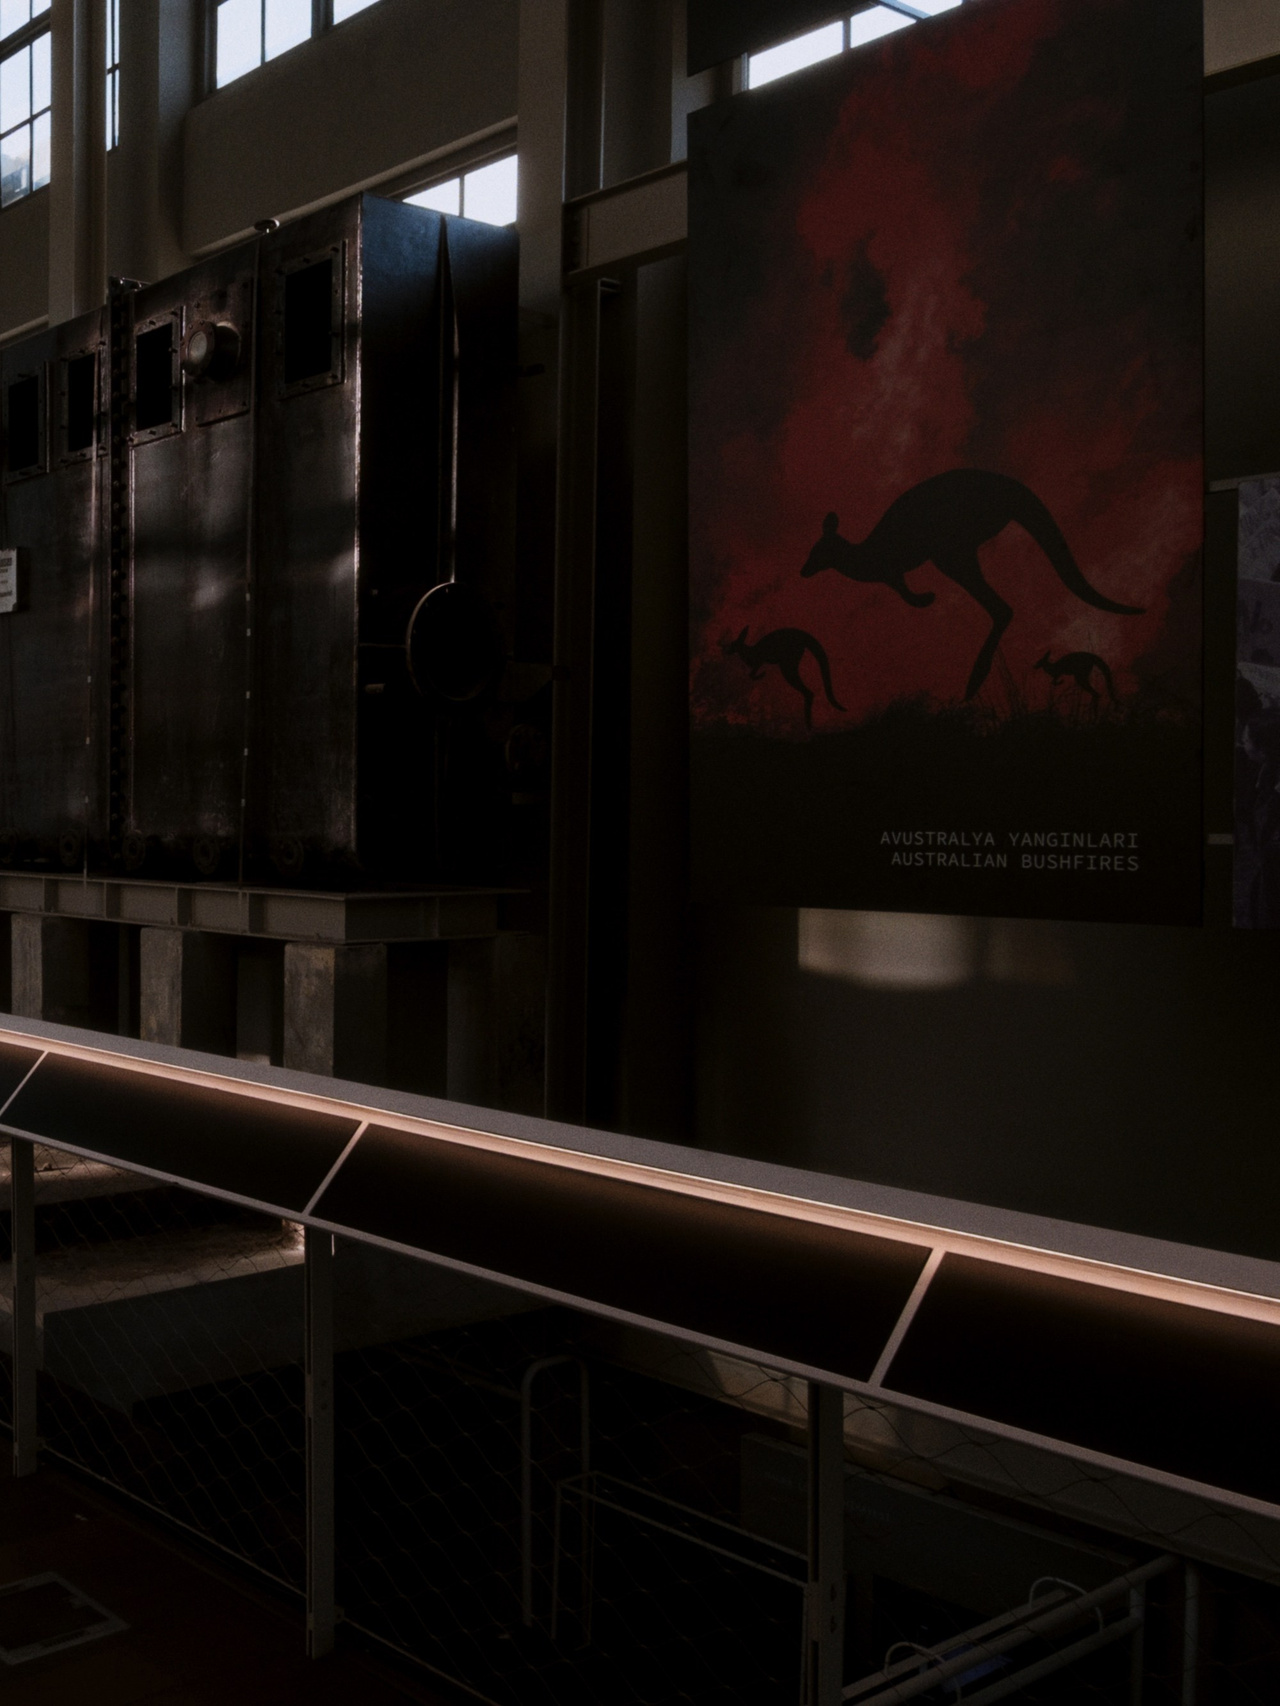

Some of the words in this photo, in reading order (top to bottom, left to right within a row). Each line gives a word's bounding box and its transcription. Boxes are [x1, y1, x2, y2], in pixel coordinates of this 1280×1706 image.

[880, 831, 996, 847] AVUSTRALYA
[1008, 832, 1140, 849] YANGINLARI
[891, 851, 1008, 868] AUSTRALIAN
[1021, 853, 1140, 872] BUSHFIRES
